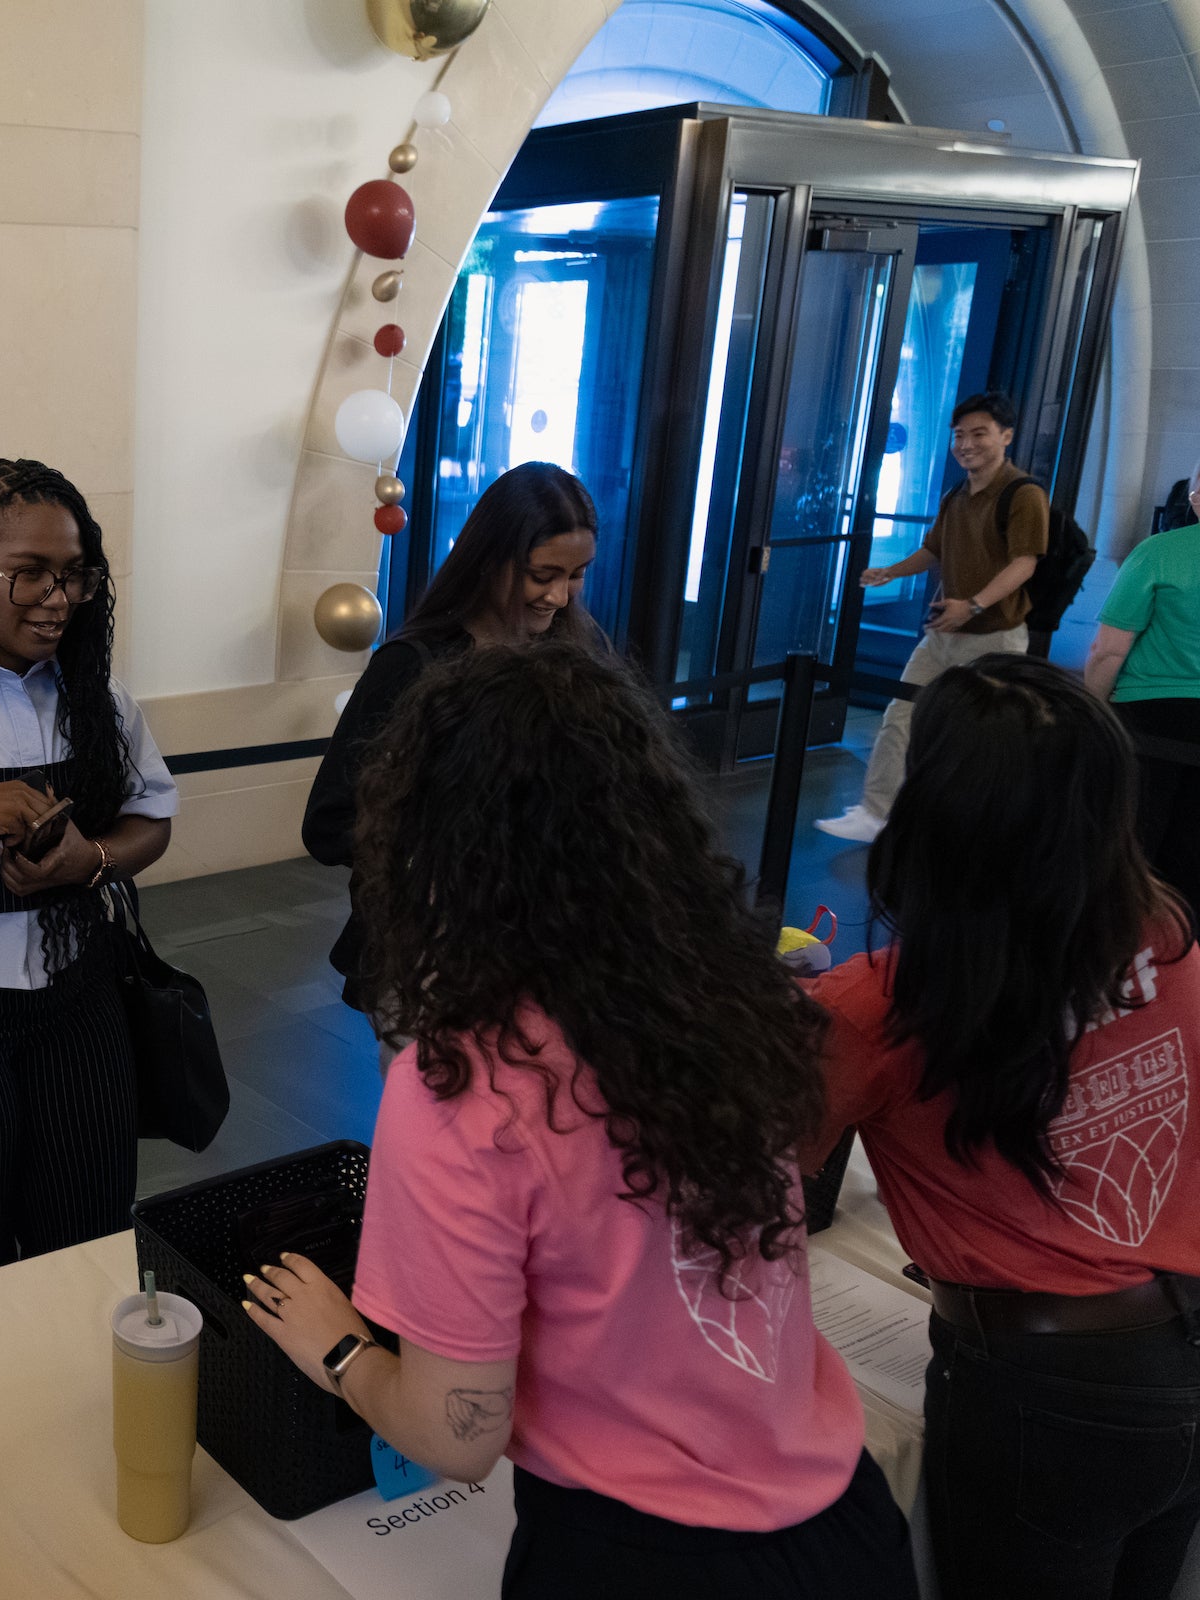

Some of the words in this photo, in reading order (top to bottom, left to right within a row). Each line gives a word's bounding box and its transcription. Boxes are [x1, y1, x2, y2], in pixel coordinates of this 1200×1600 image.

[1050, 1132, 1084, 1152] LEX
[1088, 1121, 1110, 1139] ET
[1113, 1088, 1179, 1128] IUSTITIA
[394, 1455, 411, 1478] 4
[366, 1489, 467, 1536] Section
[469, 1482, 486, 1494] 4
